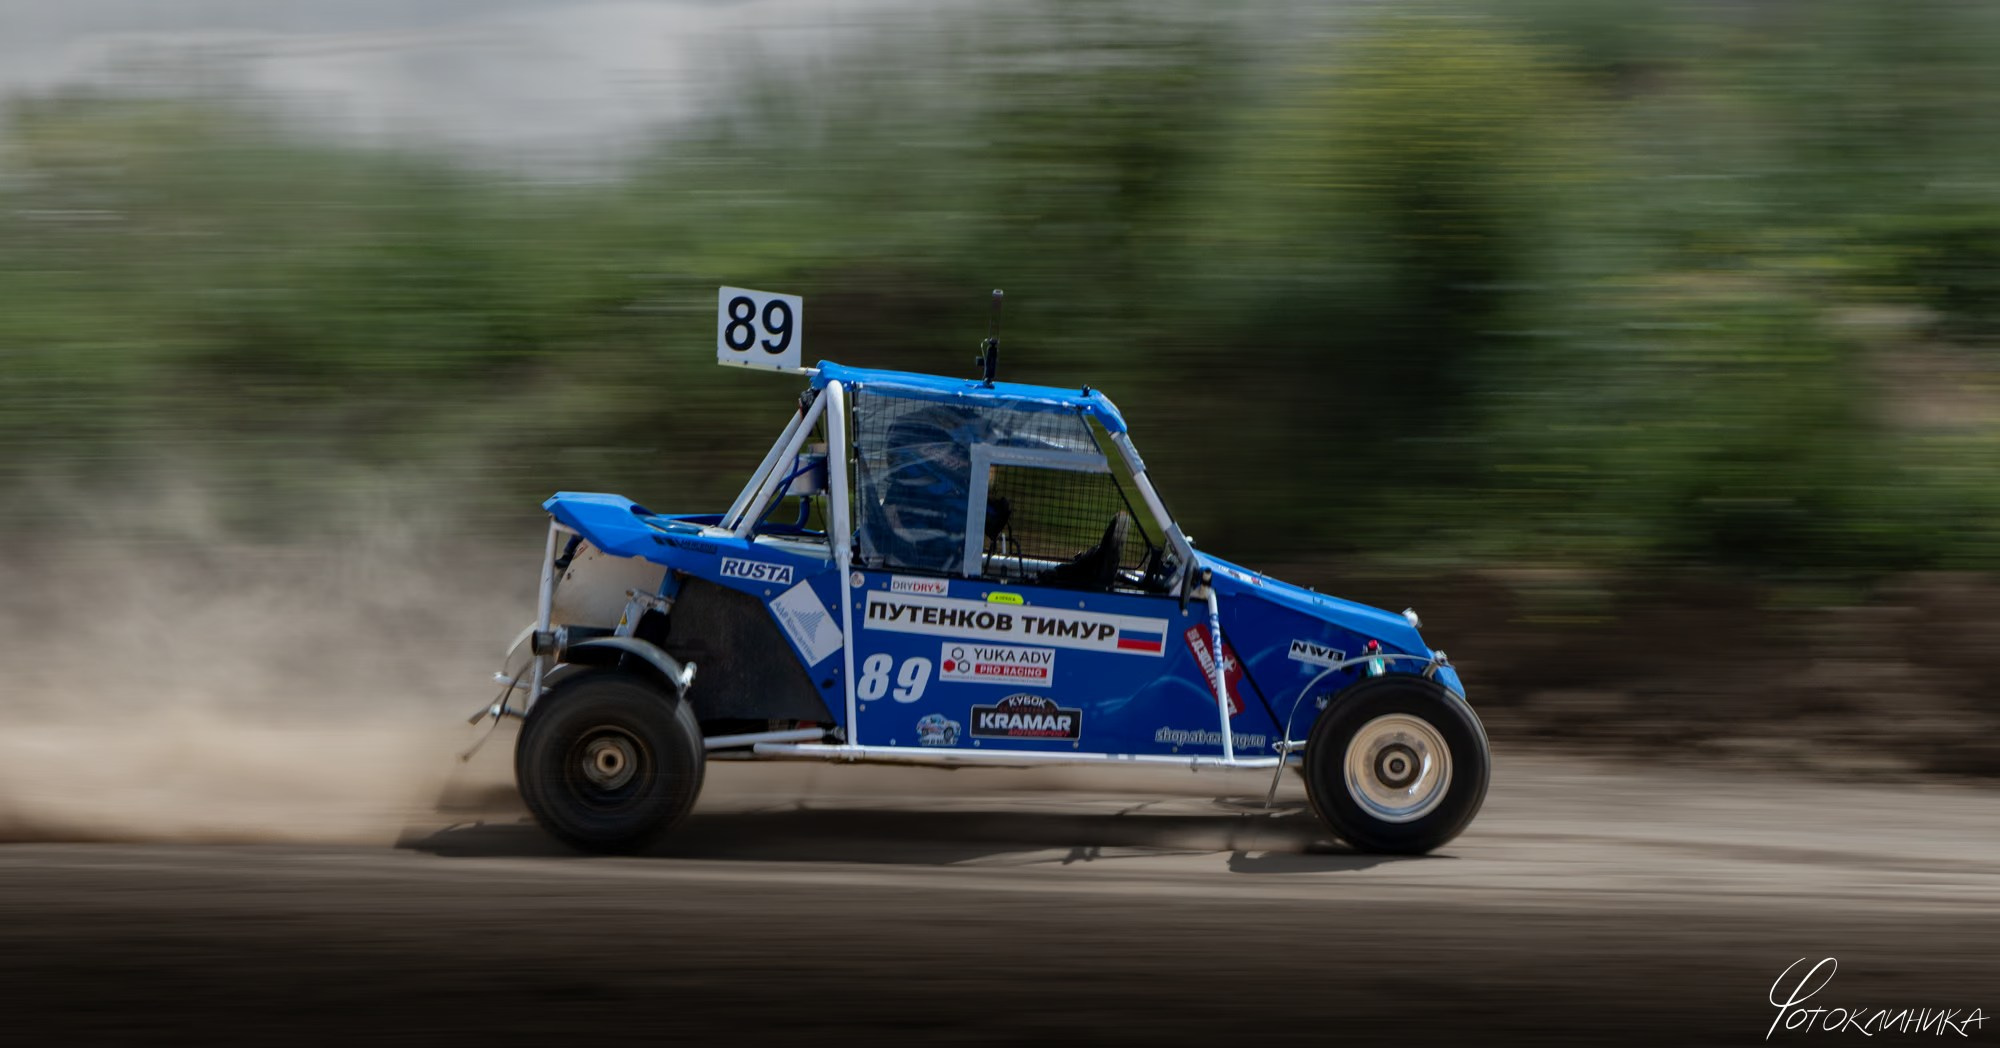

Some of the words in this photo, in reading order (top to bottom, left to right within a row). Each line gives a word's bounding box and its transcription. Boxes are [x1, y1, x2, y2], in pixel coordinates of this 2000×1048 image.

[725, 296, 793, 354] 89
[722, 559, 791, 583] RUSTA
[892, 580, 934, 592] DRYDRY
[869, 601, 1013, 631] ПУТЕНКОВ
[1022, 615, 1115, 641] ТИМУР
[974, 647, 1016, 662] YUKA
[1018, 651, 1052, 665] ADV
[1292, 641, 1344, 661] NWB
[857, 653, 932, 703] 89
[979, 664, 1001, 675] PRO
[1003, 666, 1042, 677] RACING
[1009, 695, 1047, 709] КУБОК
[980, 712, 1072, 731] KRAMAR
